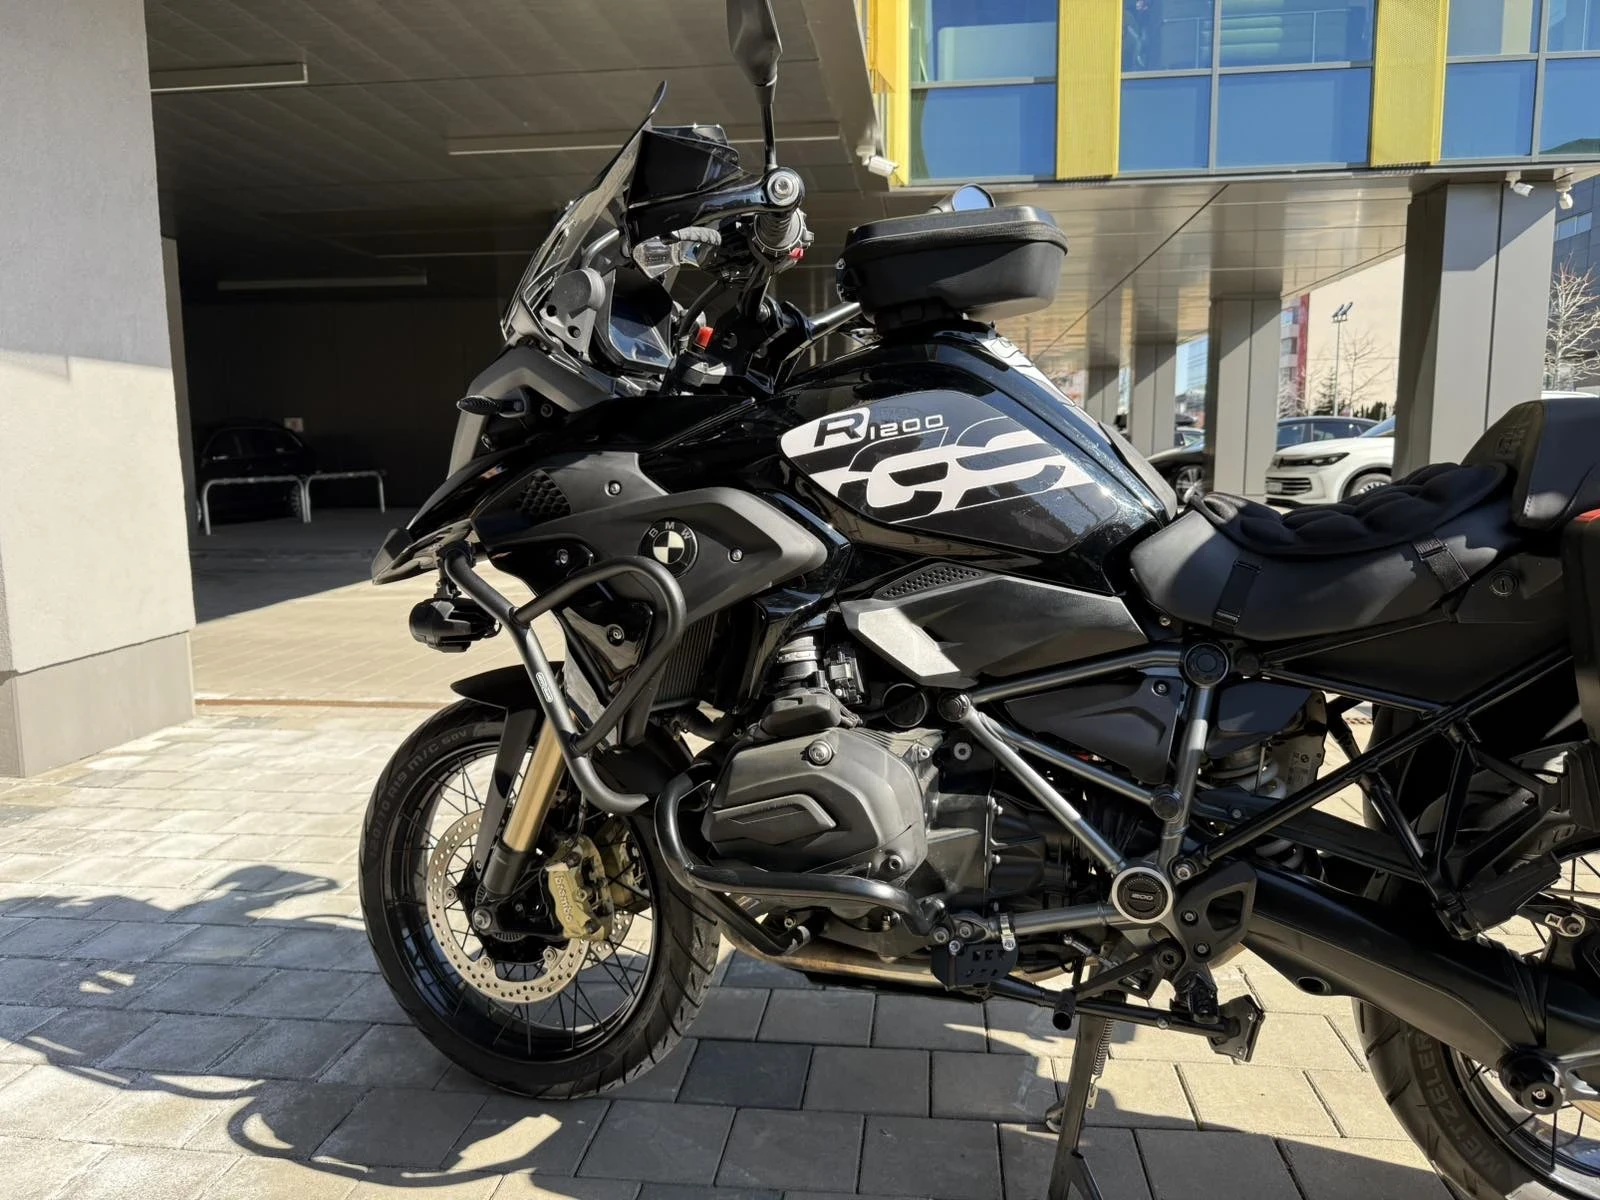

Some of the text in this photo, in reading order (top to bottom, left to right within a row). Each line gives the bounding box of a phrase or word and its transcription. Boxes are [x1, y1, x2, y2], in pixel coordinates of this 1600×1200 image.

[648, 521, 693, 540] BMW
[555, 875, 573, 921] brembo
[1413, 1032, 1506, 1178] METZELER
